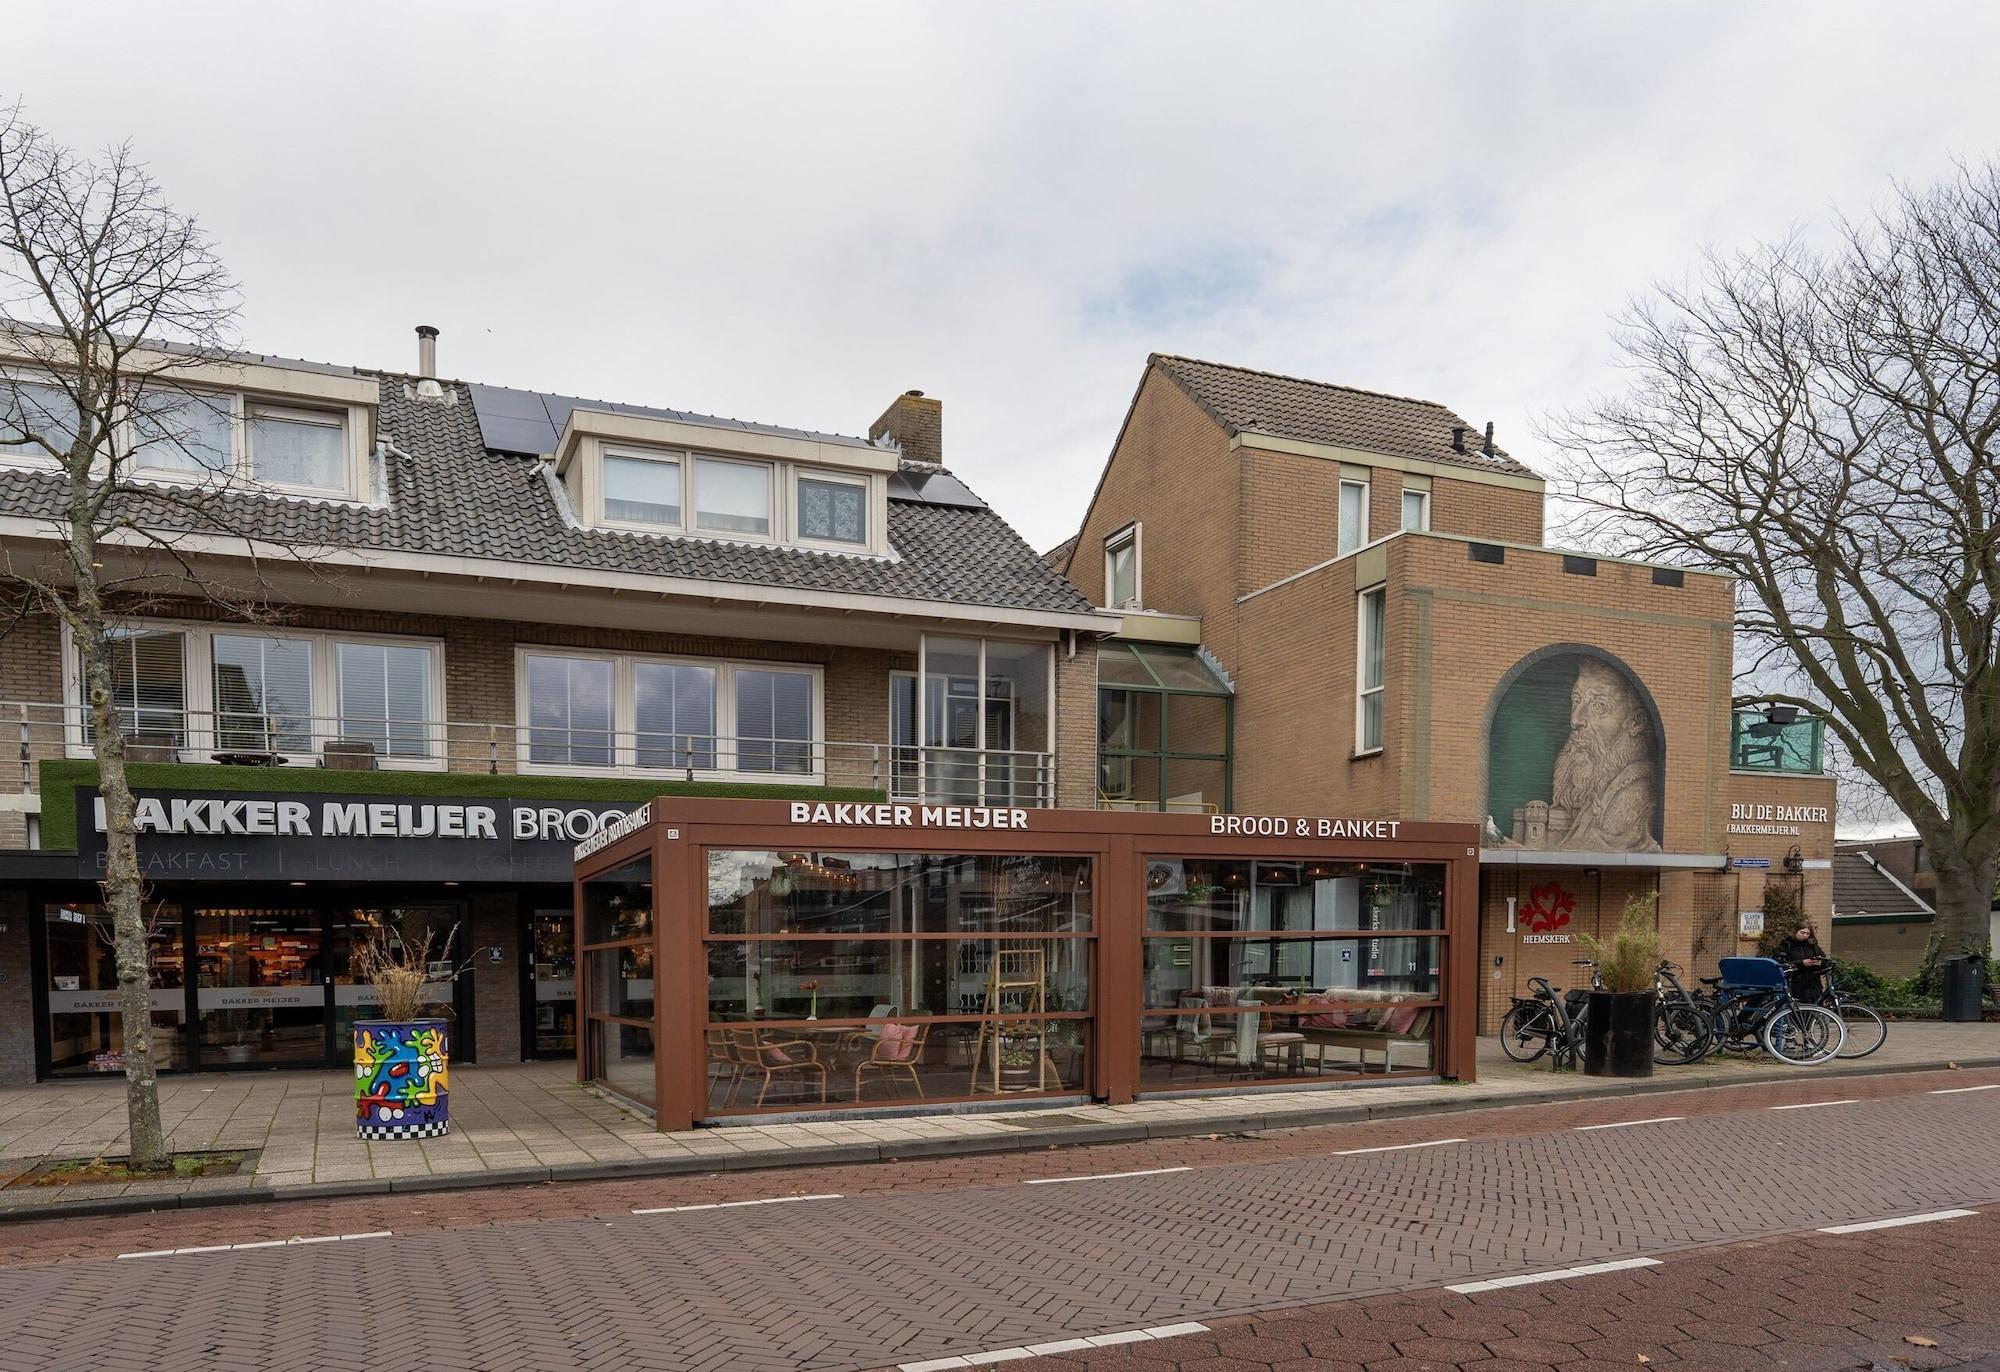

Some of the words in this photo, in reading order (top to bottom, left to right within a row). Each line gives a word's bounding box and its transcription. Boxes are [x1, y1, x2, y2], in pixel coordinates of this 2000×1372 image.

[322, 802, 498, 839] MEIJER
[513, 807, 628, 841] BROO
[790, 802, 913, 826] BAKKER
[921, 805, 1028, 829] MEIJER
[1731, 803, 1753, 820] BIJ
[1756, 804, 1773, 820] DE
[1775, 805, 1828, 822] BAKKER
[1211, 816, 1288, 836] BROOD
[1295, 818, 1310, 837] &
[1317, 819, 1400, 838] BANKET
[95, 851, 249, 871] BEAKFAST
[314, 853, 400, 871] LUNCH
[1506, 897, 1517, 933] I
[1371, 939, 1380, 959] tudio
[1523, 935, 1570, 944] HEEMSKERK
[1408, 962, 1416, 971] 11
[73, 1001, 114, 1009] BAKKER
